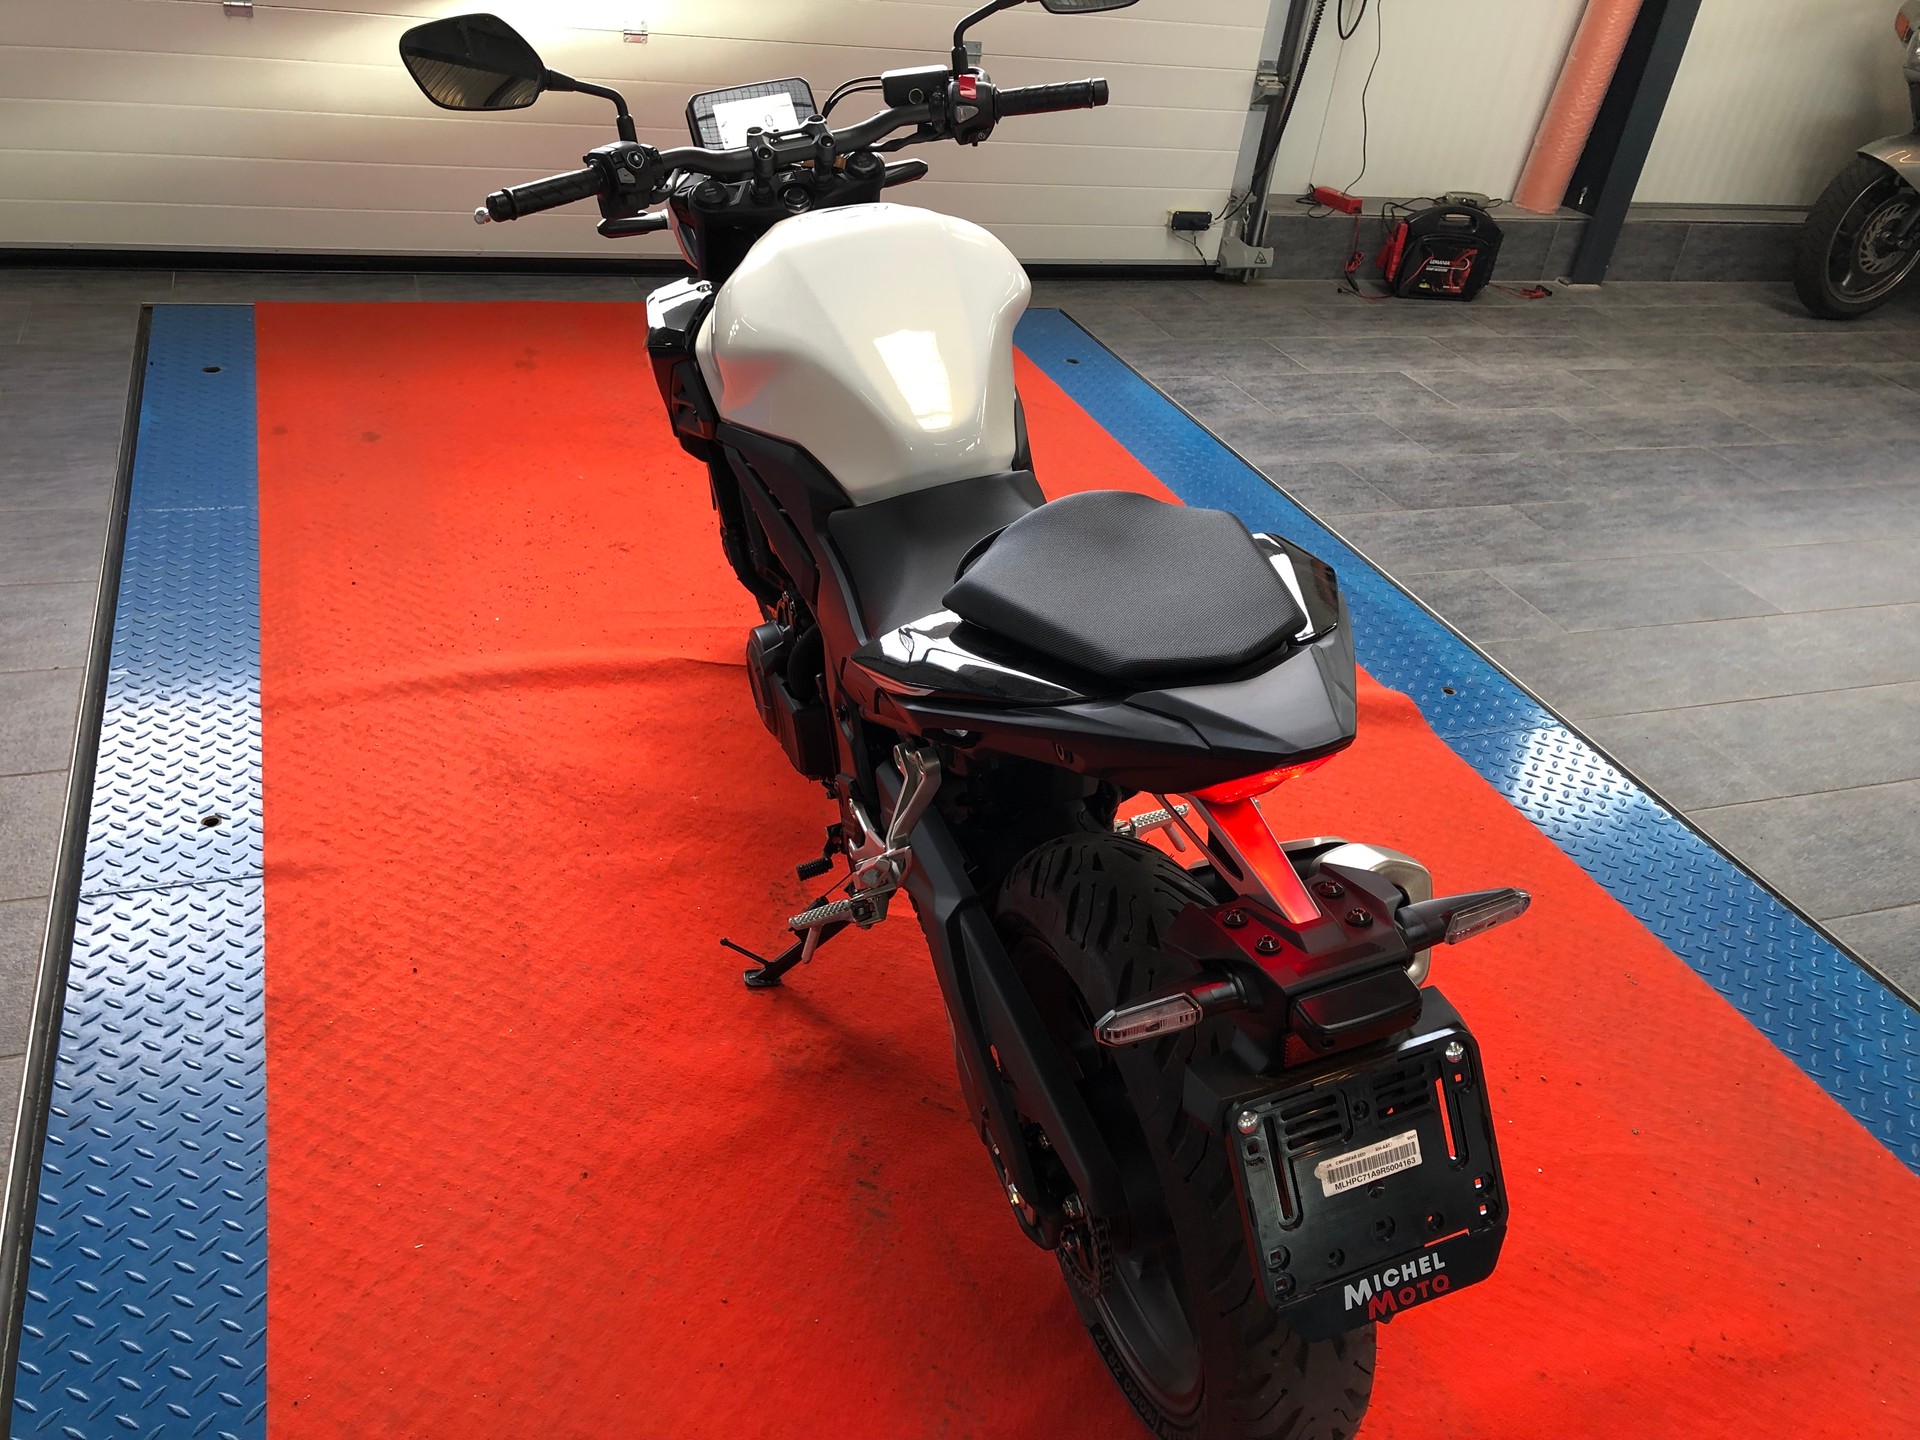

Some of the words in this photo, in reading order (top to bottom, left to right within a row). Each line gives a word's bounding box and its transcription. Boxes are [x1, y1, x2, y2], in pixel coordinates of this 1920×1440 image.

[1334, 1156, 1416, 1191] MLHPC71A9R5004163
[1344, 1252, 1446, 1311] MICHEL
[1368, 1274, 1450, 1320] MOTO
